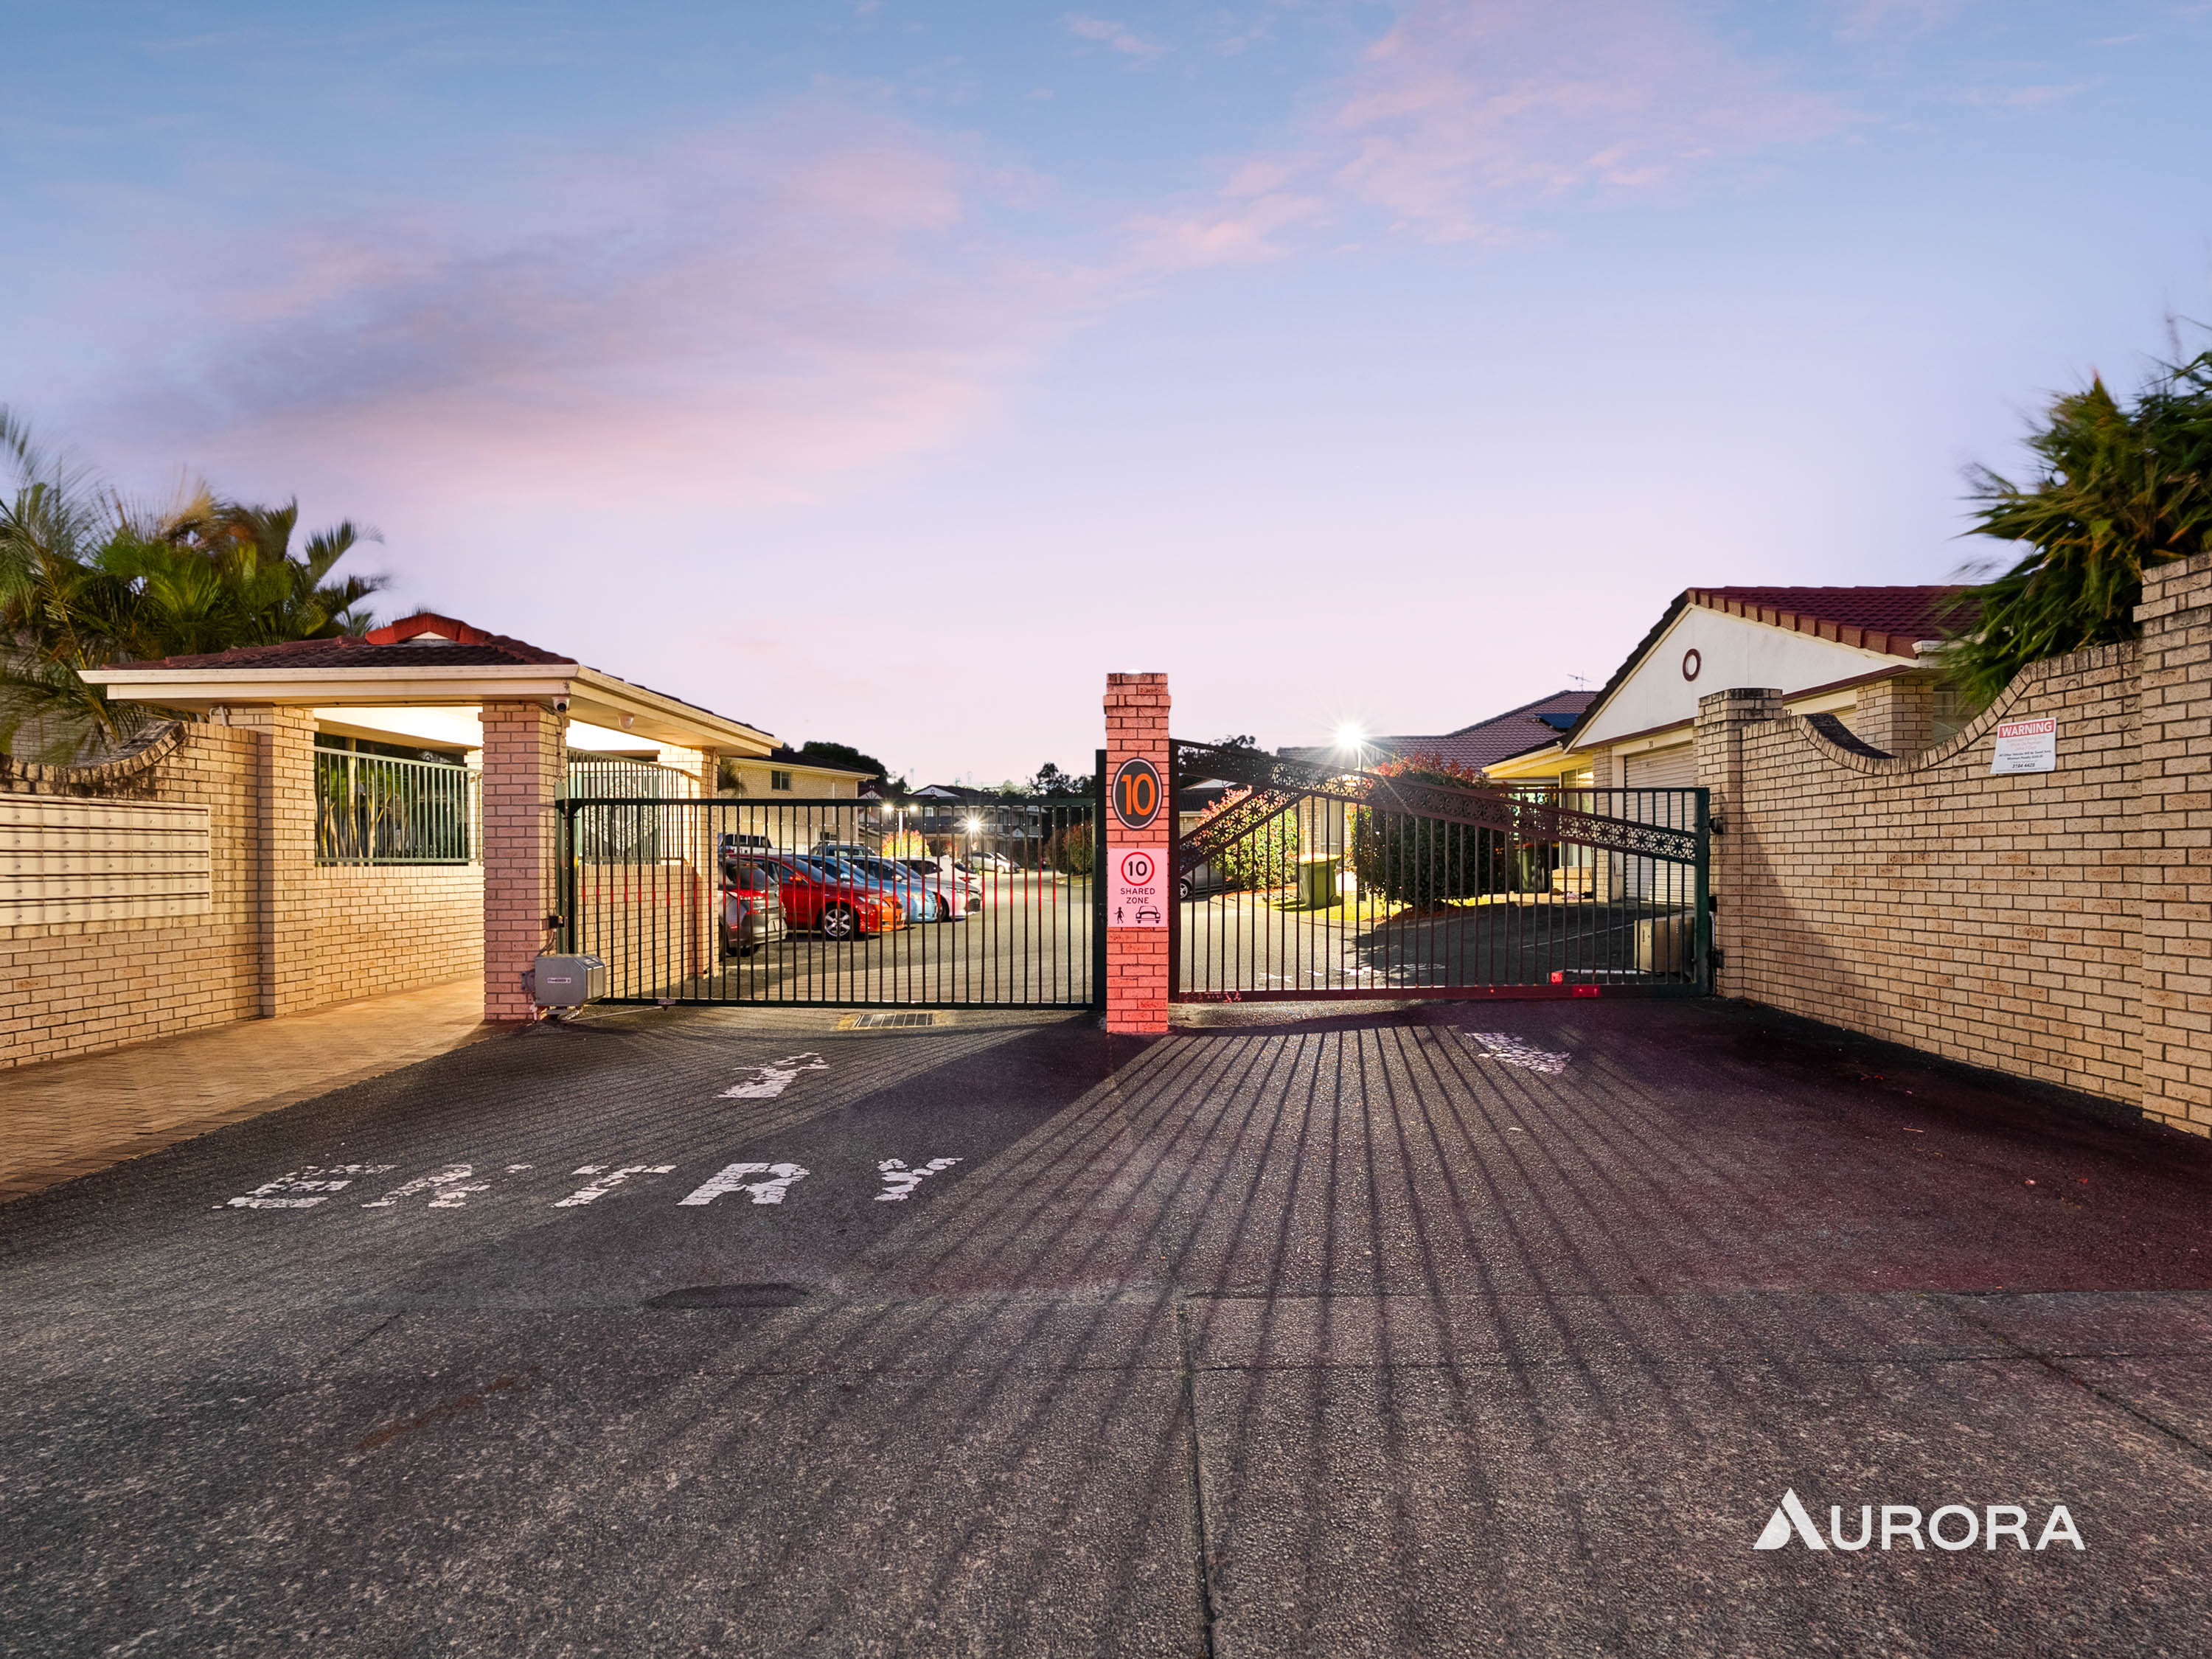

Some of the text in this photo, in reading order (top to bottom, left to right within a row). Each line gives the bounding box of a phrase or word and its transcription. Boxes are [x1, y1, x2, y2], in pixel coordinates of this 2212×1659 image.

[2001, 722, 2052, 737] WARNING
[1121, 773, 1155, 816] 10
[1128, 860, 1147, 877] 10
